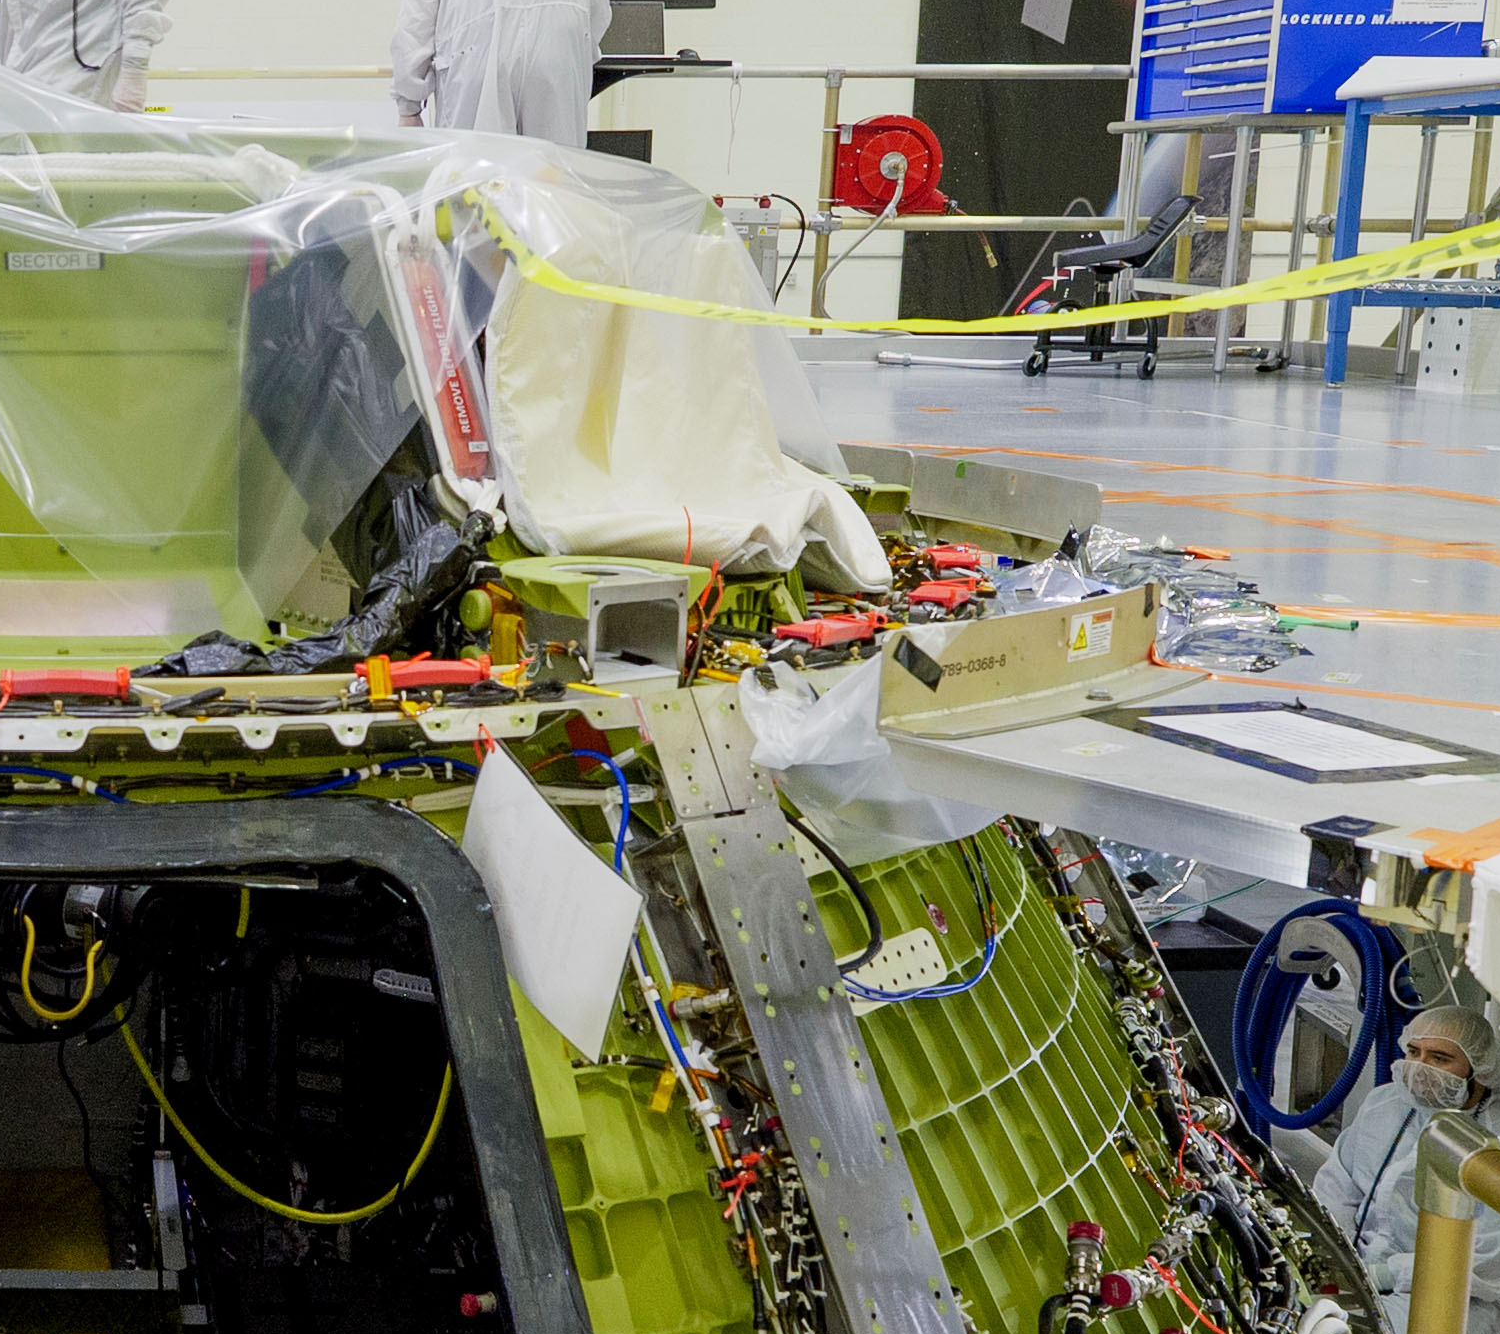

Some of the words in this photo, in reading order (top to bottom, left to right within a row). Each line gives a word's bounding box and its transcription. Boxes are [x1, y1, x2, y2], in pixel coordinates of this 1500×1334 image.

[1280, 13, 1367, 26] LOCKHEED
[11, 253, 81, 268] SECTOR
[86, 253, 97, 267] E
[451, 379, 472, 434] REMOVE
